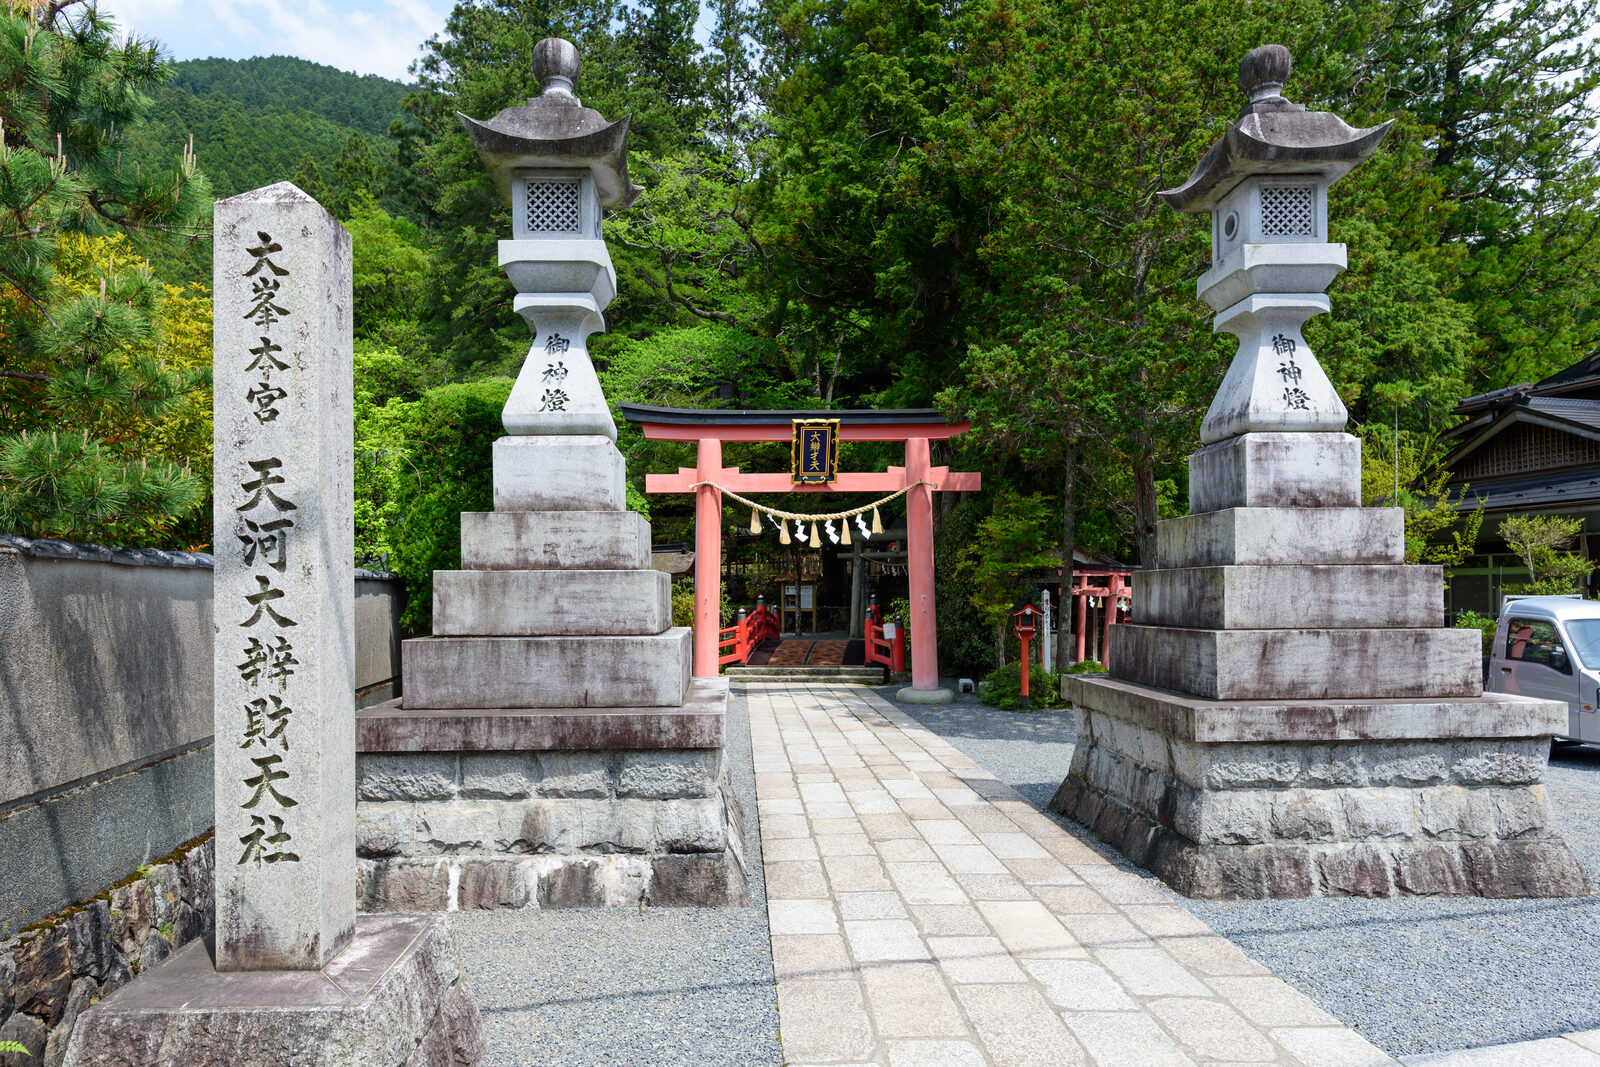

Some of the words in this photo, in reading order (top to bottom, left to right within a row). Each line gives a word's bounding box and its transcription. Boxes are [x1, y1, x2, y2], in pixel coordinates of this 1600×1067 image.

[538, 333, 571, 412] 御神燈
[1271, 333, 1310, 410] 御神燈
